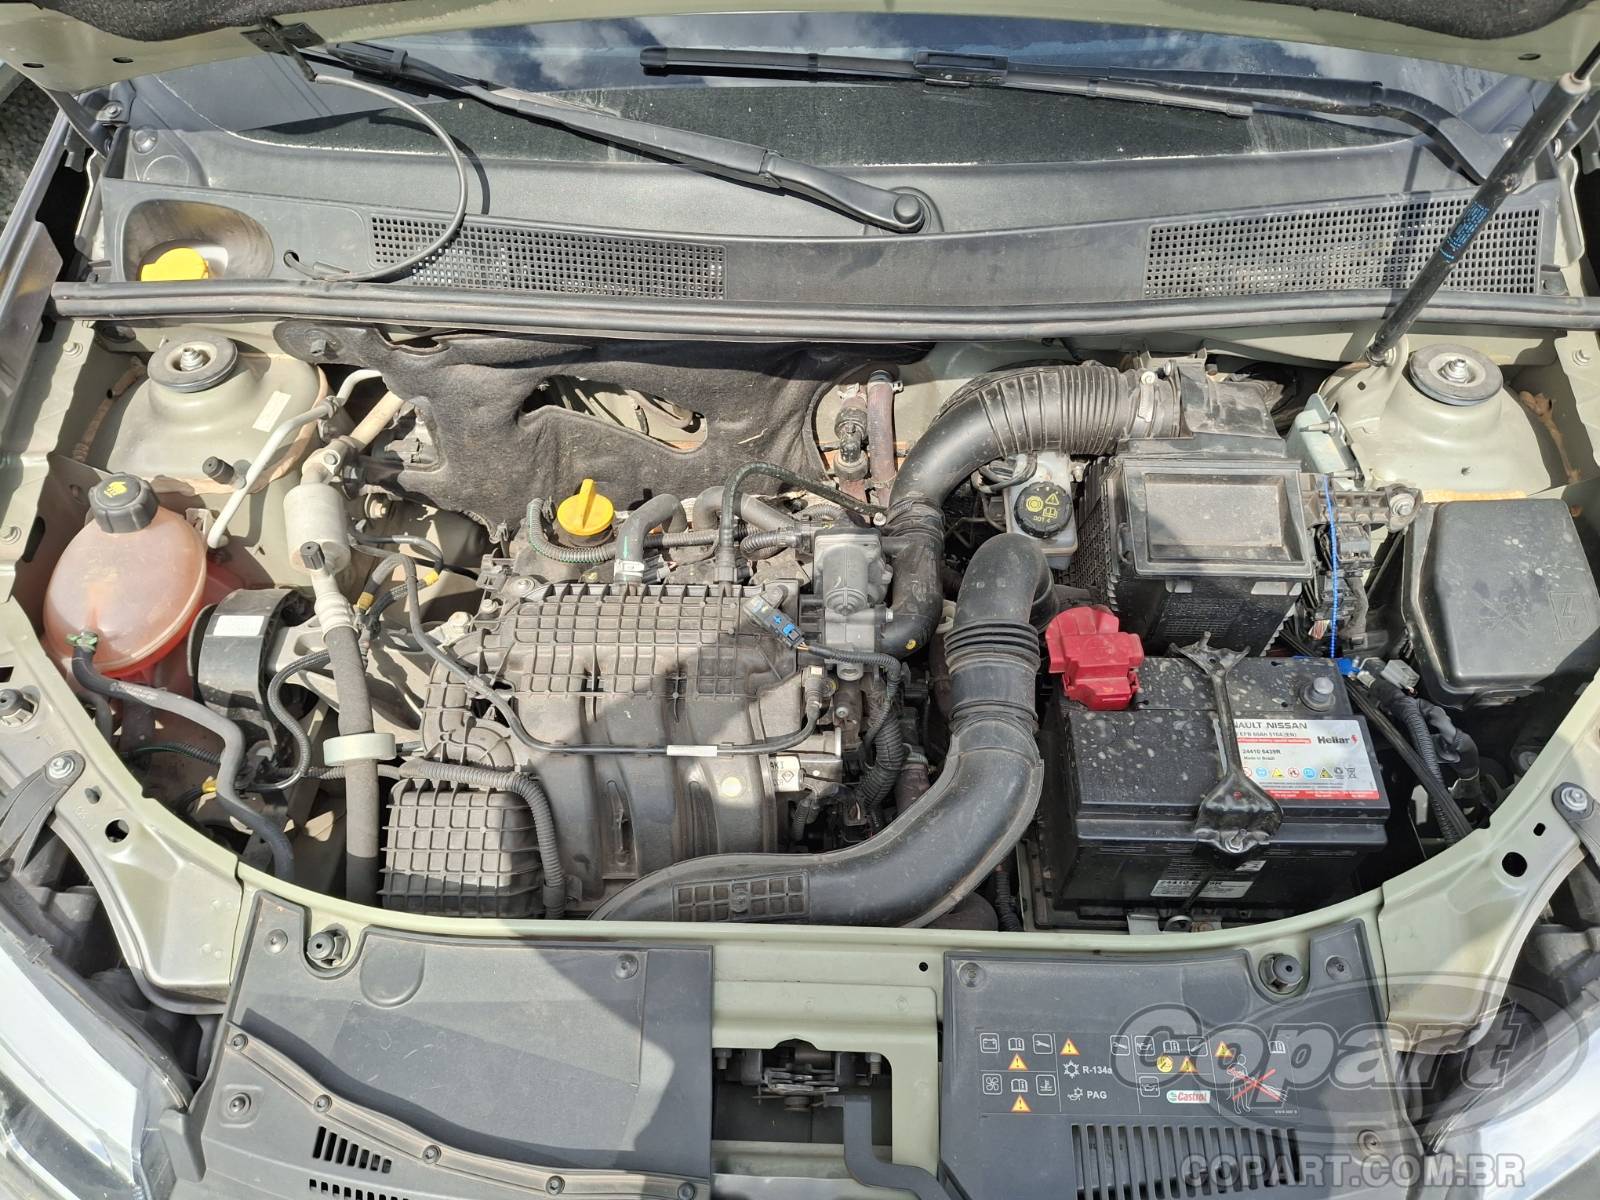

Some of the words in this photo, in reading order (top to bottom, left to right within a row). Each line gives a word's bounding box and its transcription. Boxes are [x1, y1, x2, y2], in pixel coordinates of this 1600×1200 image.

[1033, 516, 1045, 524] DOT
[1234, 721, 1262, 729] NAULT
[1317, 735, 1350, 744] Heliar
[1082, 1066, 1112, 1074] R-134a
[1086, 1090, 1107, 1099] PAG
[1177, 1091, 1208, 1102] Castrol
